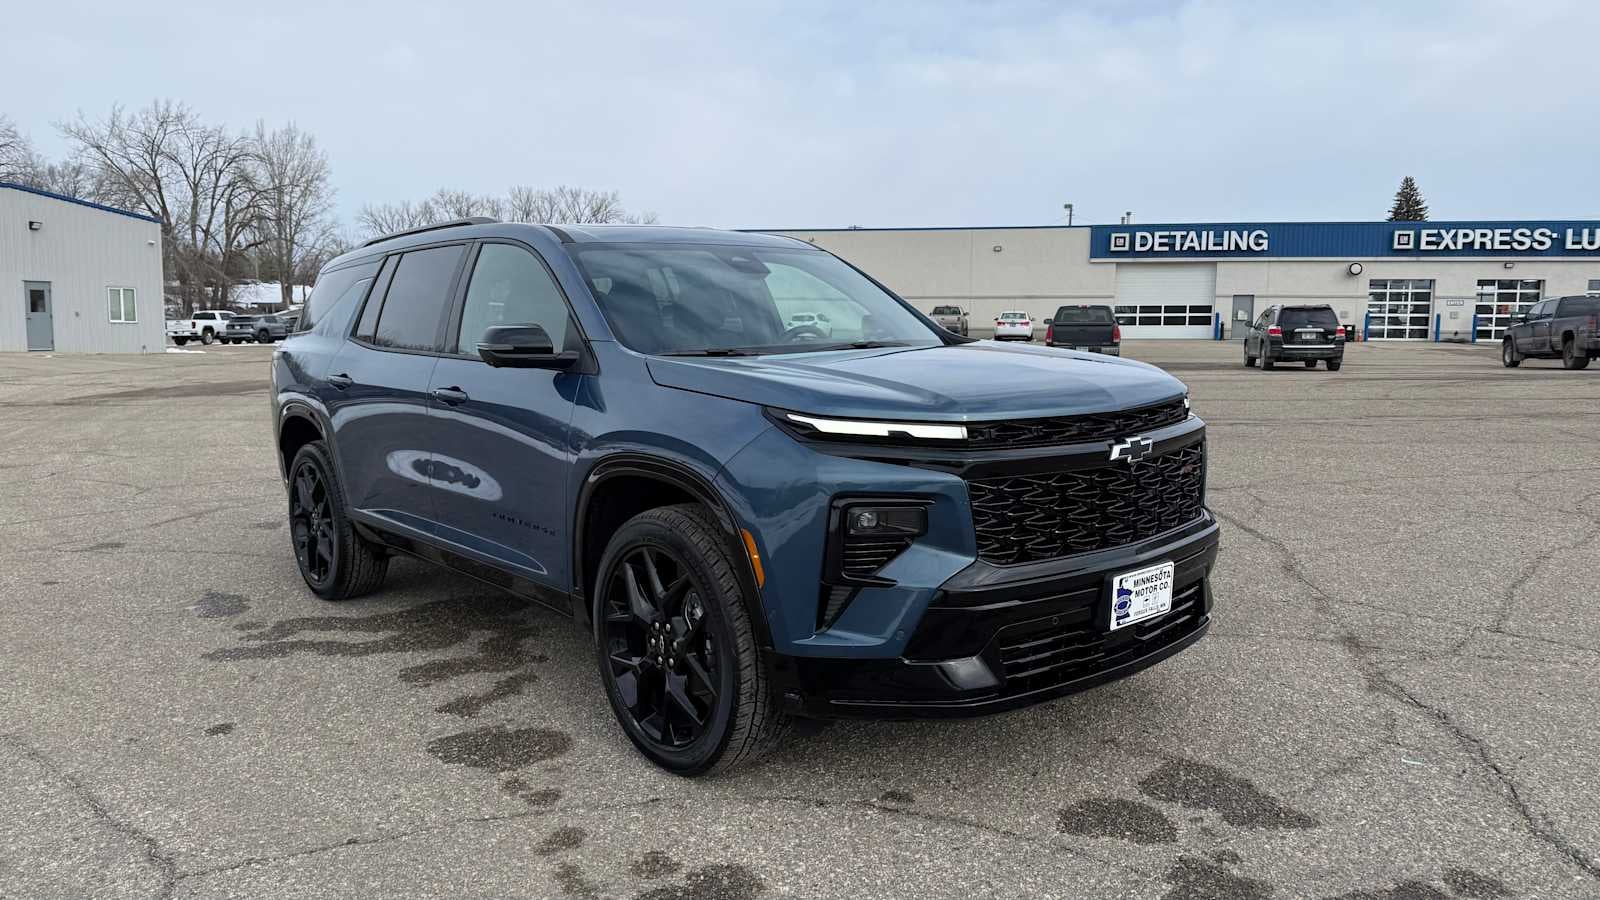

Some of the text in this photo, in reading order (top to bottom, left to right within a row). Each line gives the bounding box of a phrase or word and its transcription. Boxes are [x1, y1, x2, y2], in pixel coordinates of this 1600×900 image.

[1135, 229, 1269, 251] DETAILING
[1419, 228, 1553, 250] EXPRESS
[1133, 570, 1171, 588] MINNESOTA
[1135, 584, 1158, 598] MOTOR
